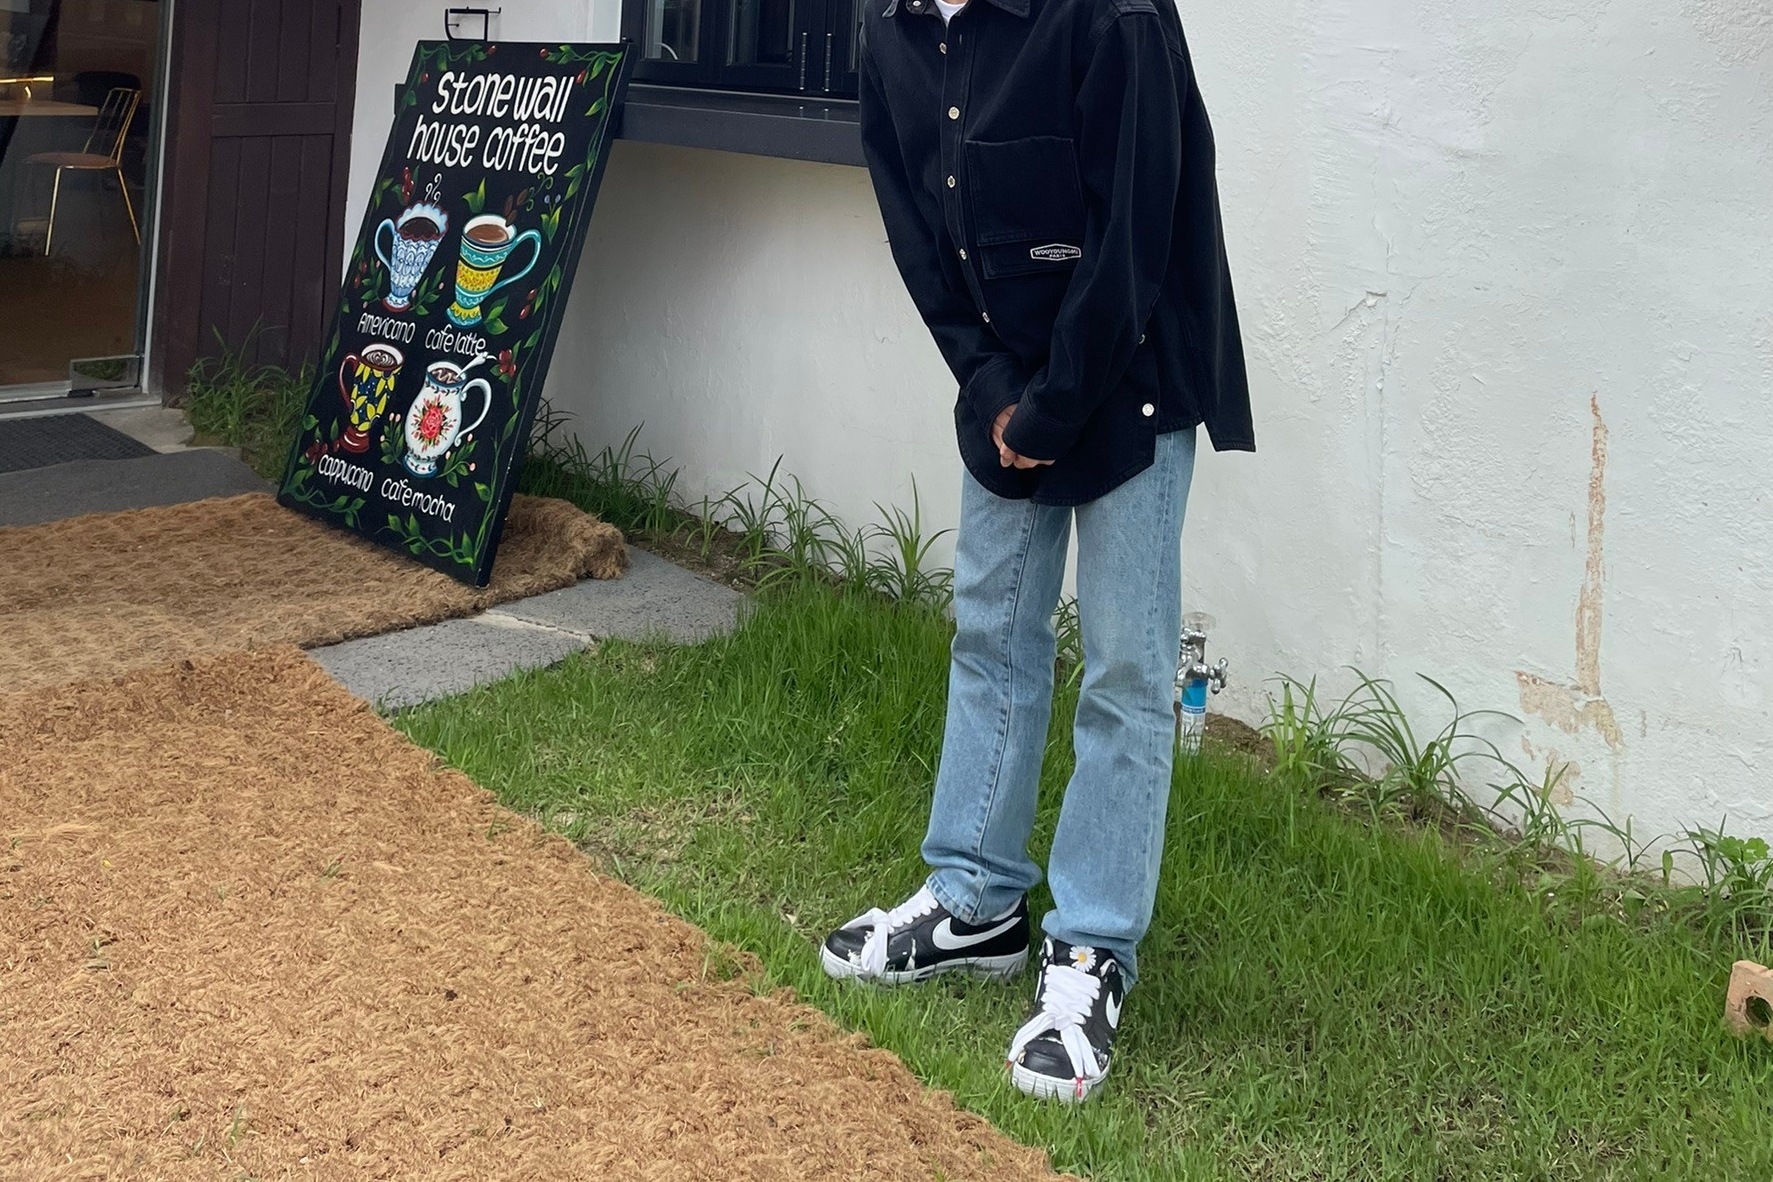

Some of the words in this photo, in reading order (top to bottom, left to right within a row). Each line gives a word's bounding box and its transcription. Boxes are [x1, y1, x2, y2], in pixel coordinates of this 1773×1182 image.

[407, 114, 480, 167] house
[482, 123, 565, 175] coffee
[357, 312, 415, 344] Americano
[318, 454, 374, 493] cappuccino
